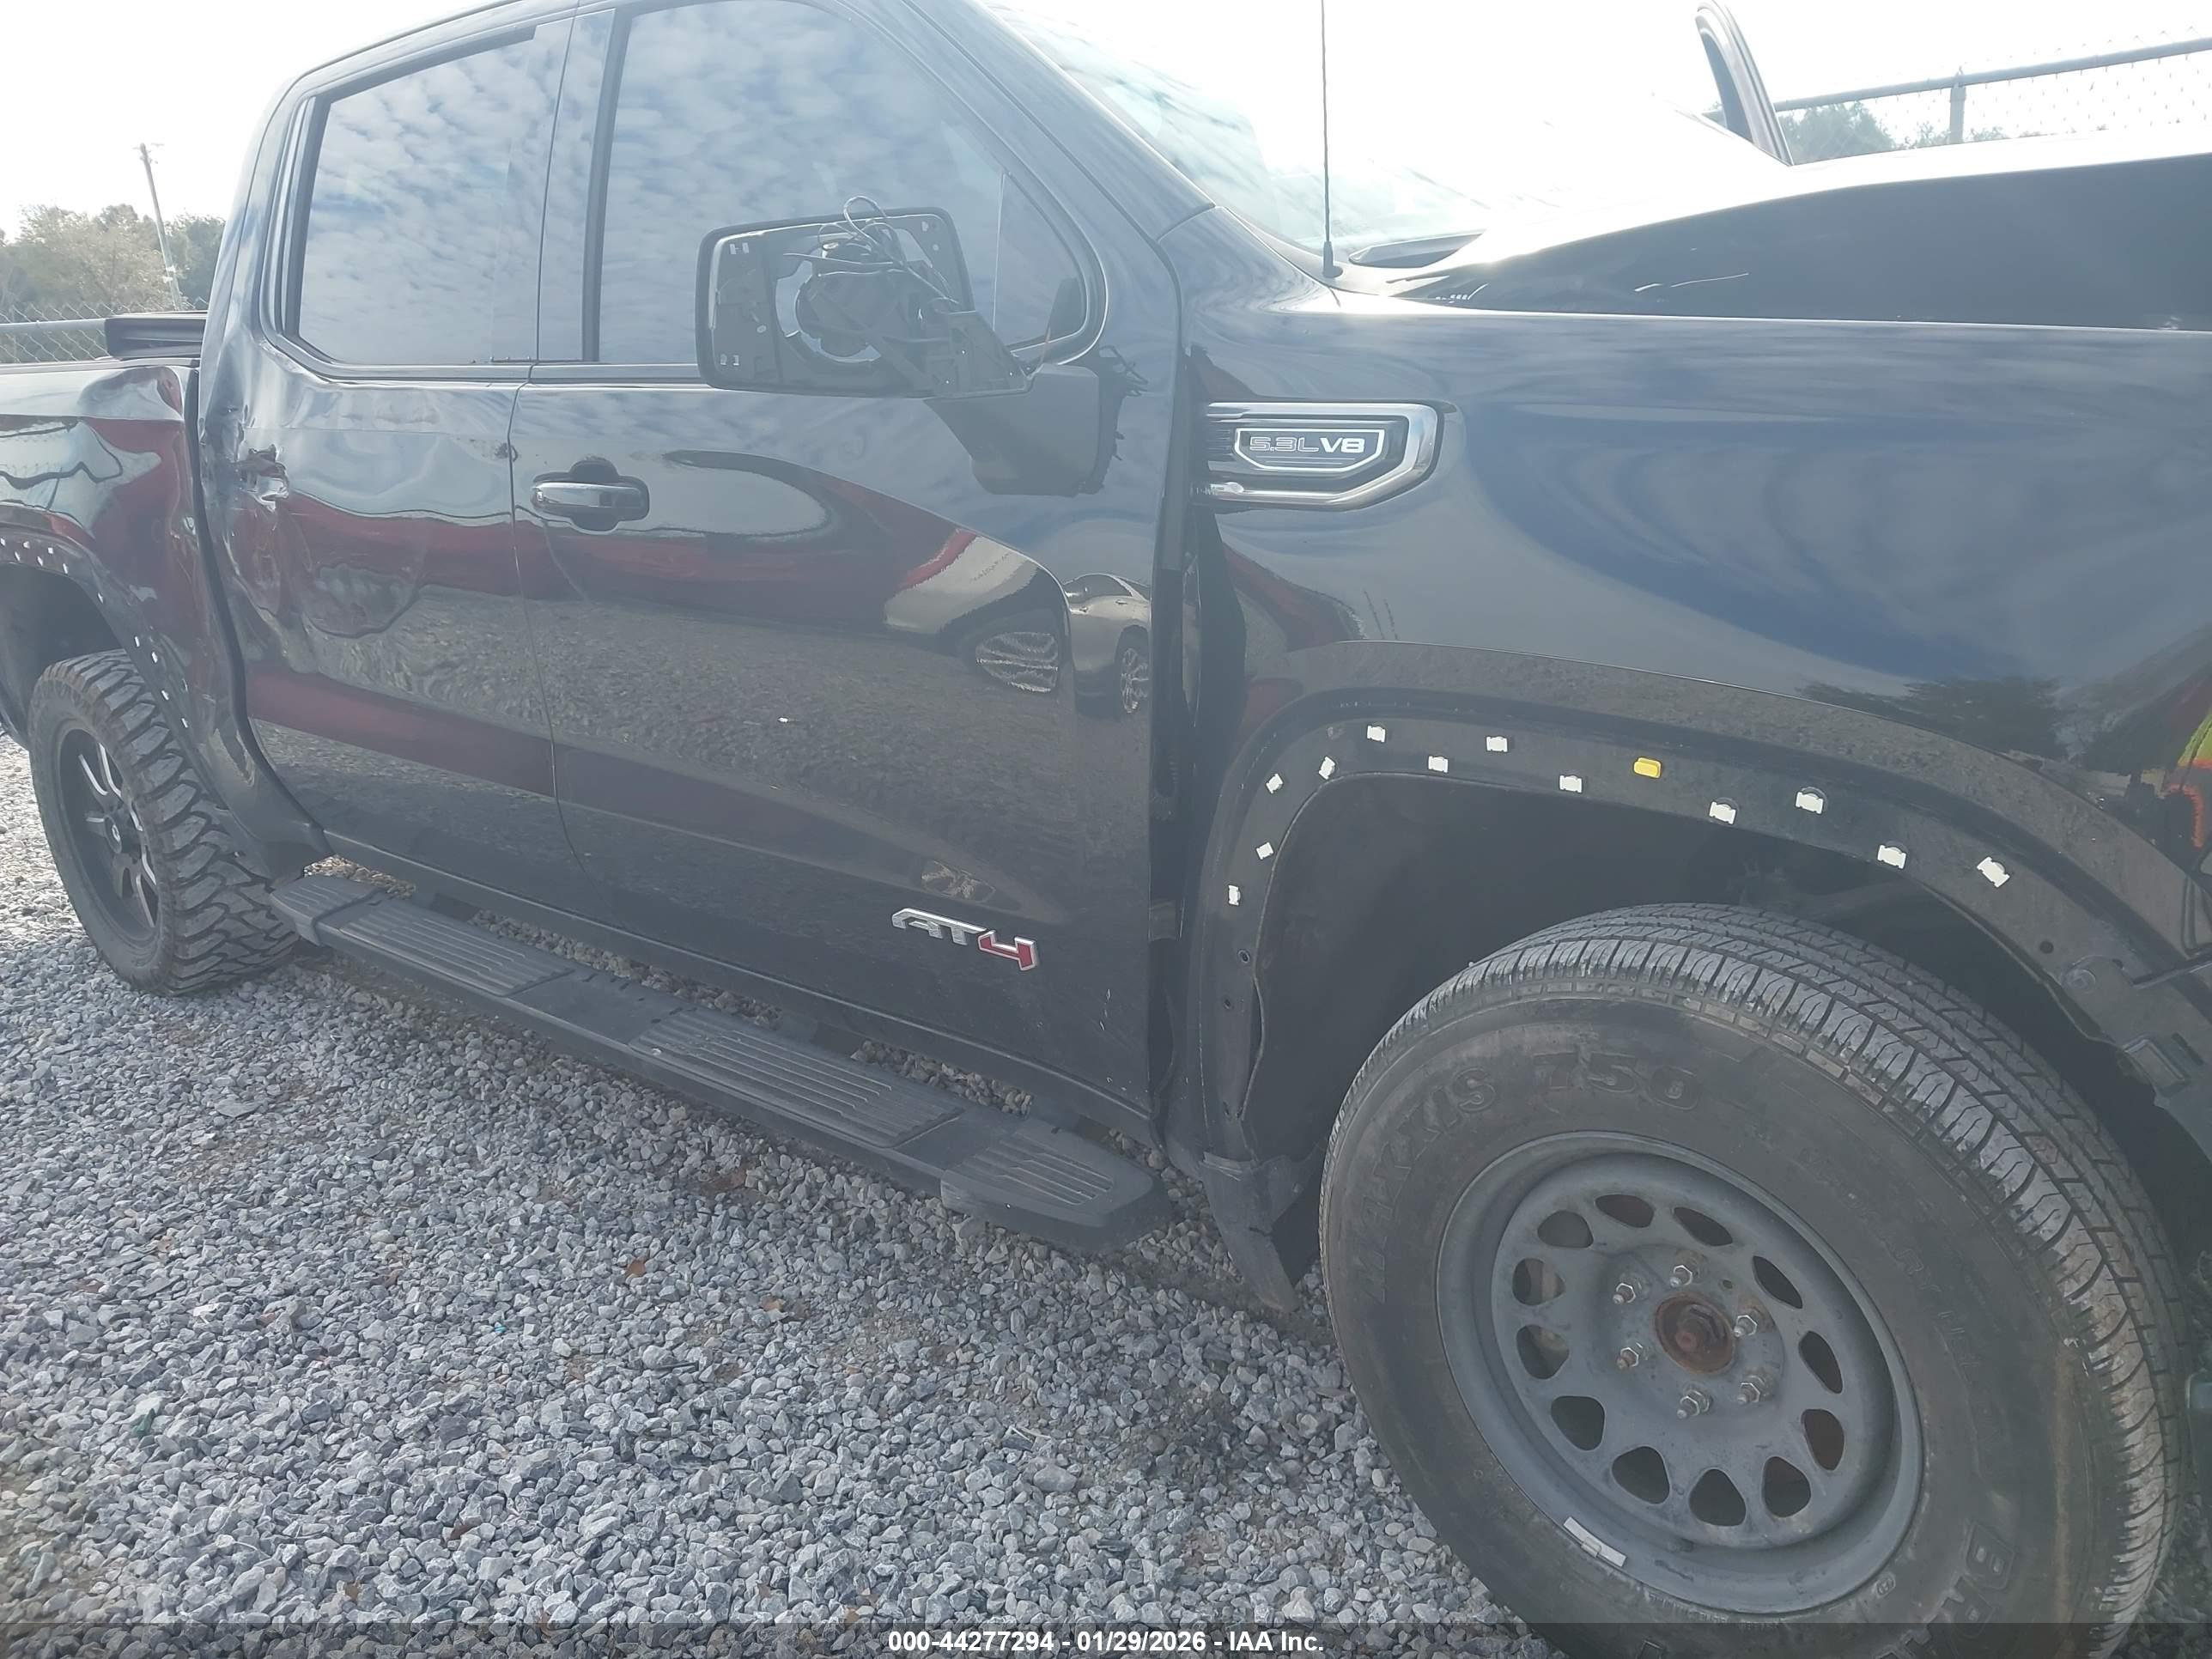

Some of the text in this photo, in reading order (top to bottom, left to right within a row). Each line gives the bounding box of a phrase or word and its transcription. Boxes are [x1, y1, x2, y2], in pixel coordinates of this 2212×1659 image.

[891, 907, 1037, 971] AT4
[1356, 1049, 1704, 1305] MAXXIS 750
